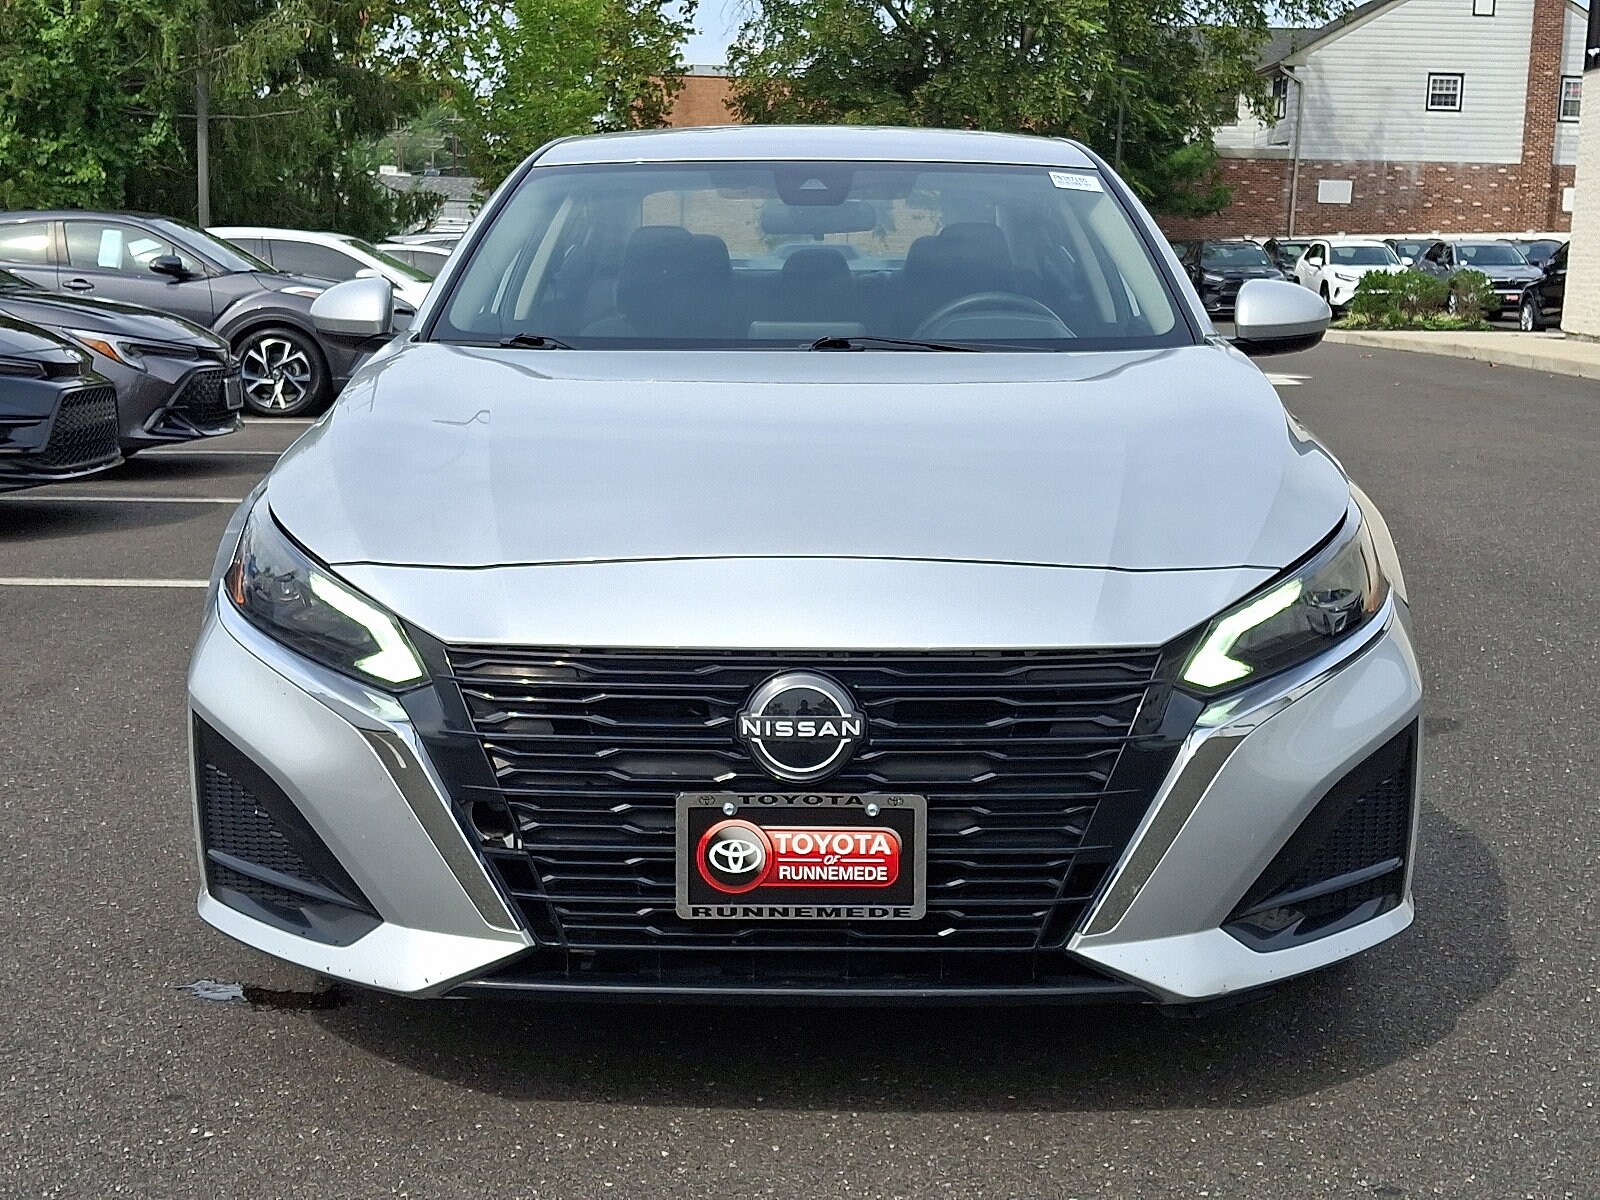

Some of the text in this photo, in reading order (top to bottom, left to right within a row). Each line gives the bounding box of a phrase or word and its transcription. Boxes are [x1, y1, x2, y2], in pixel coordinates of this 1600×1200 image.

[741, 718, 860, 737] NISSAN
[737, 794, 864, 806] TOYOTA
[774, 833, 892, 855] TOYOTA
[778, 865, 888, 882] RUNNEMEDE
[691, 906, 912, 919] RUNNEMEDE
